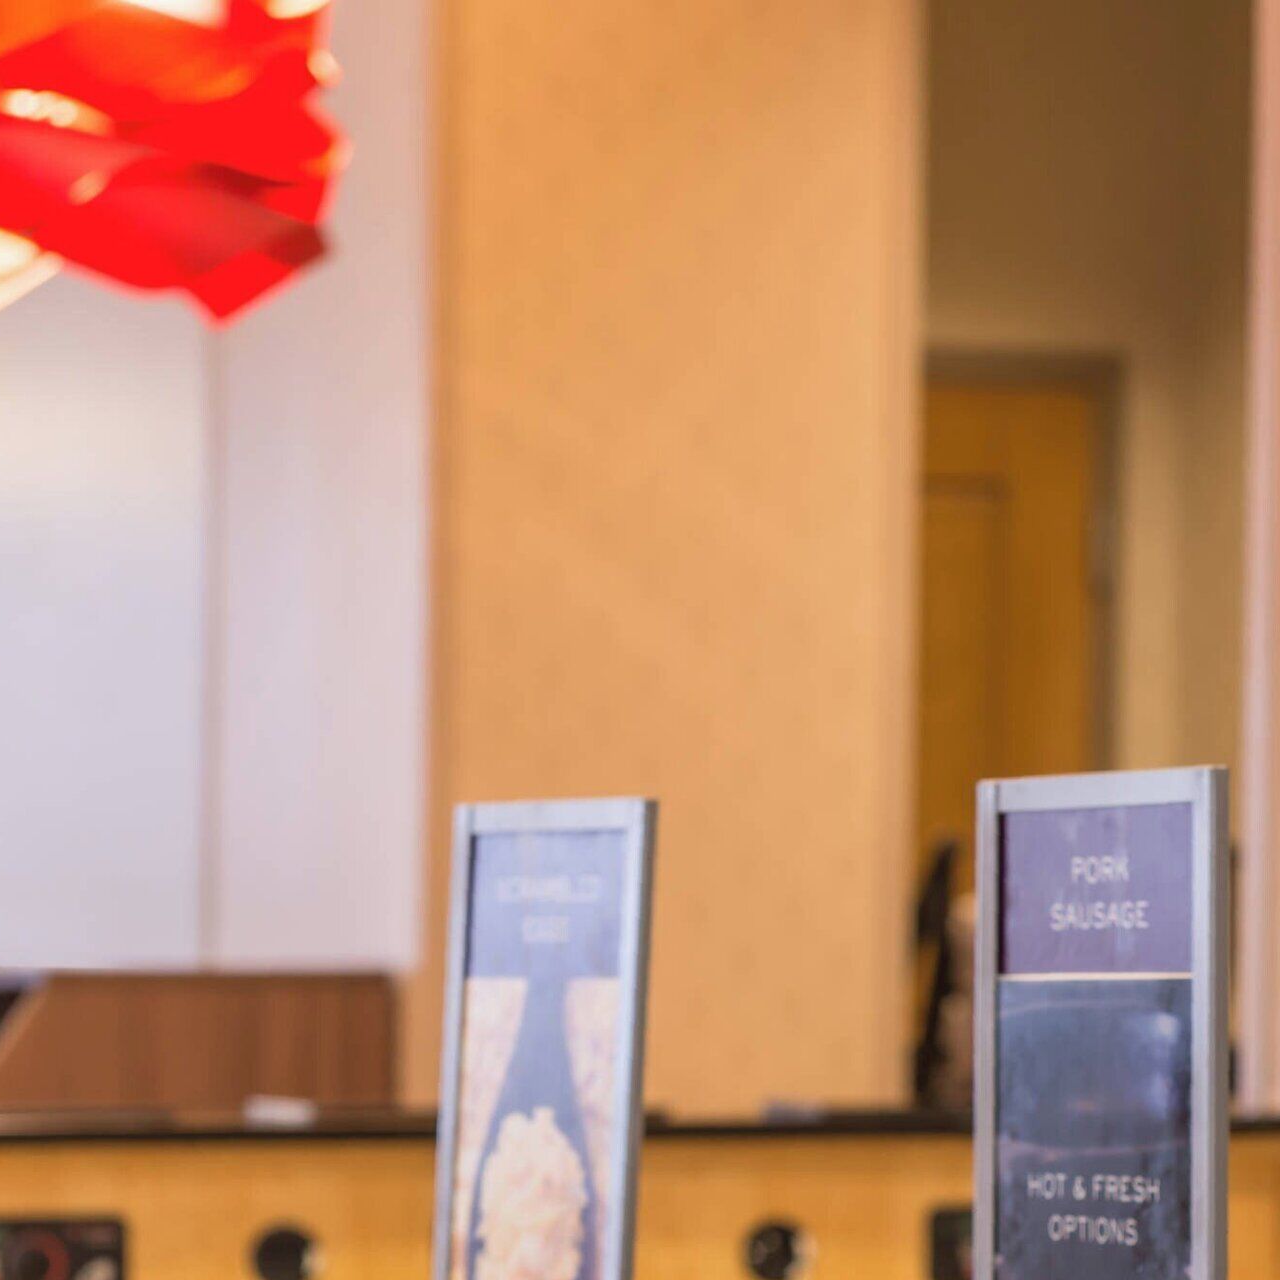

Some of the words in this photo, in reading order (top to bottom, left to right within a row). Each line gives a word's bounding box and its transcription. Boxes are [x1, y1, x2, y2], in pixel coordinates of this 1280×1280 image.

[1070, 855, 1130, 884] PORK
[1049, 900, 1150, 931] SAUSAGE
[1026, 1171, 1067, 1200] HOT
[1072, 1175, 1087, 1201] &
[1091, 1173, 1162, 1203] FRESH
[1046, 1213, 1139, 1247] OPTIONS
